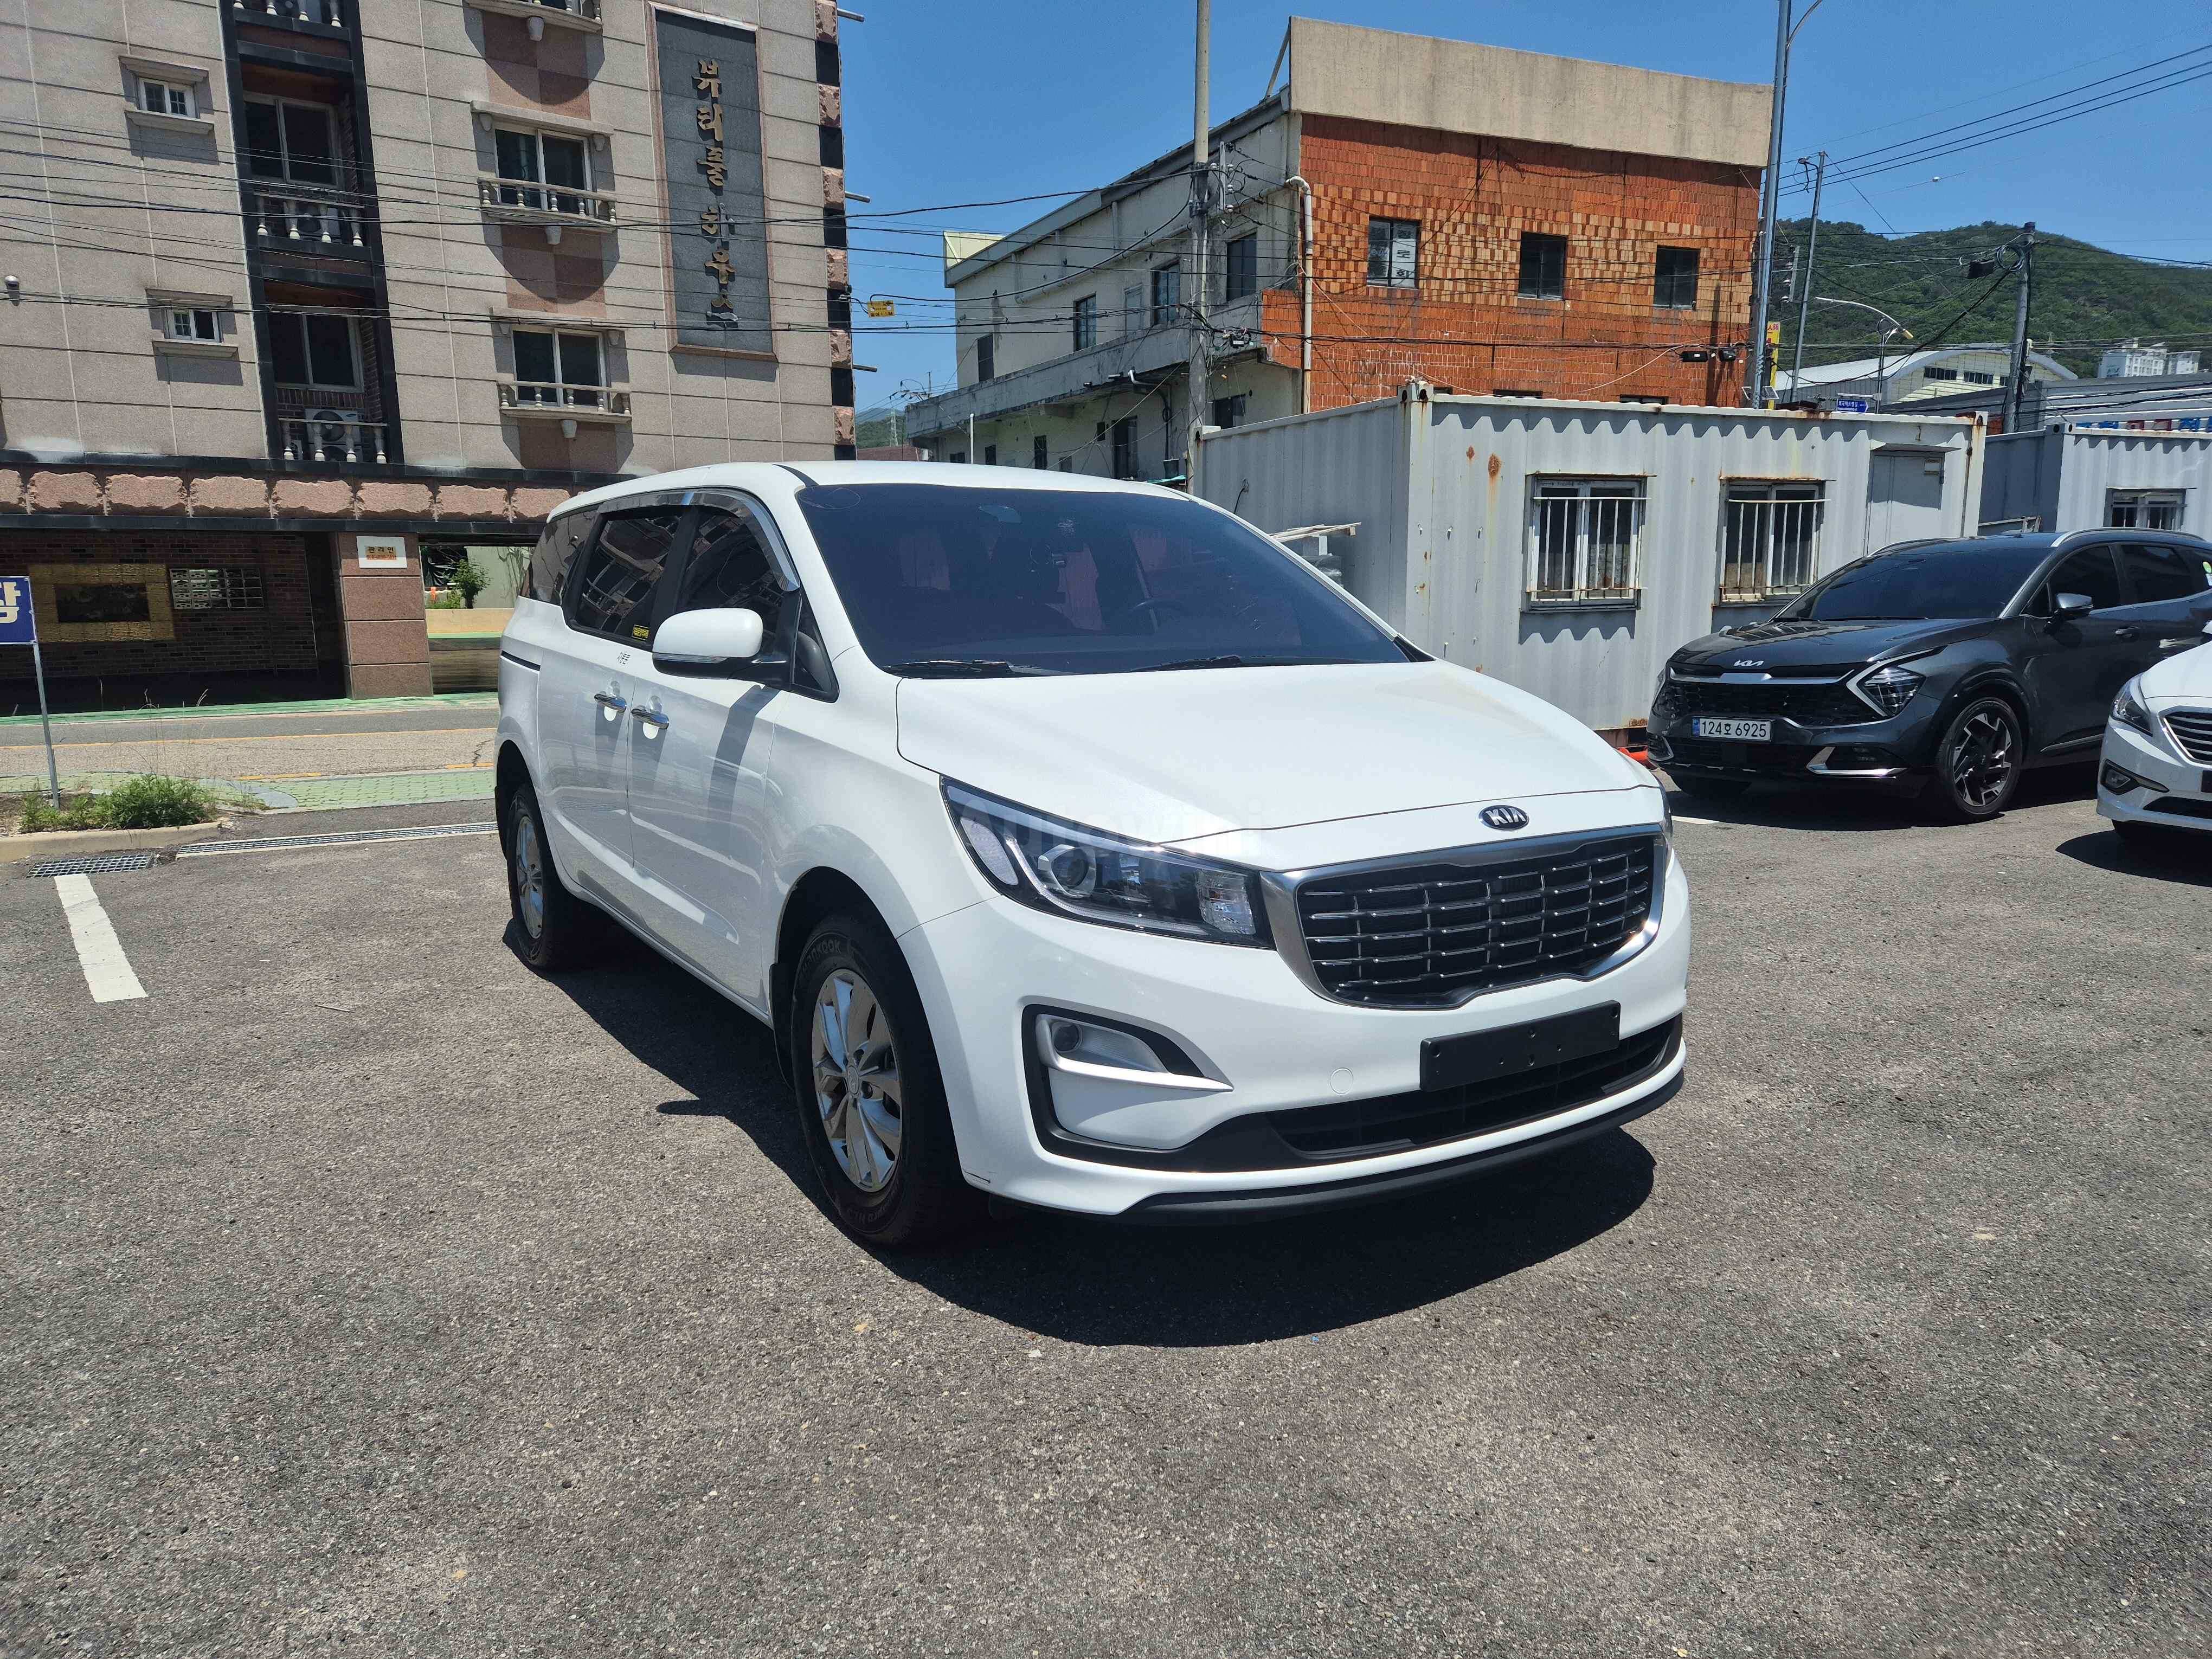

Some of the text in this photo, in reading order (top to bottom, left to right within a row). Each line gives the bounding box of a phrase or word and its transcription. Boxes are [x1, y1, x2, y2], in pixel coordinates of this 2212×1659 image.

[1702, 721, 1766, 738] 124호 6925
[1485, 807, 1527, 826] KIA
